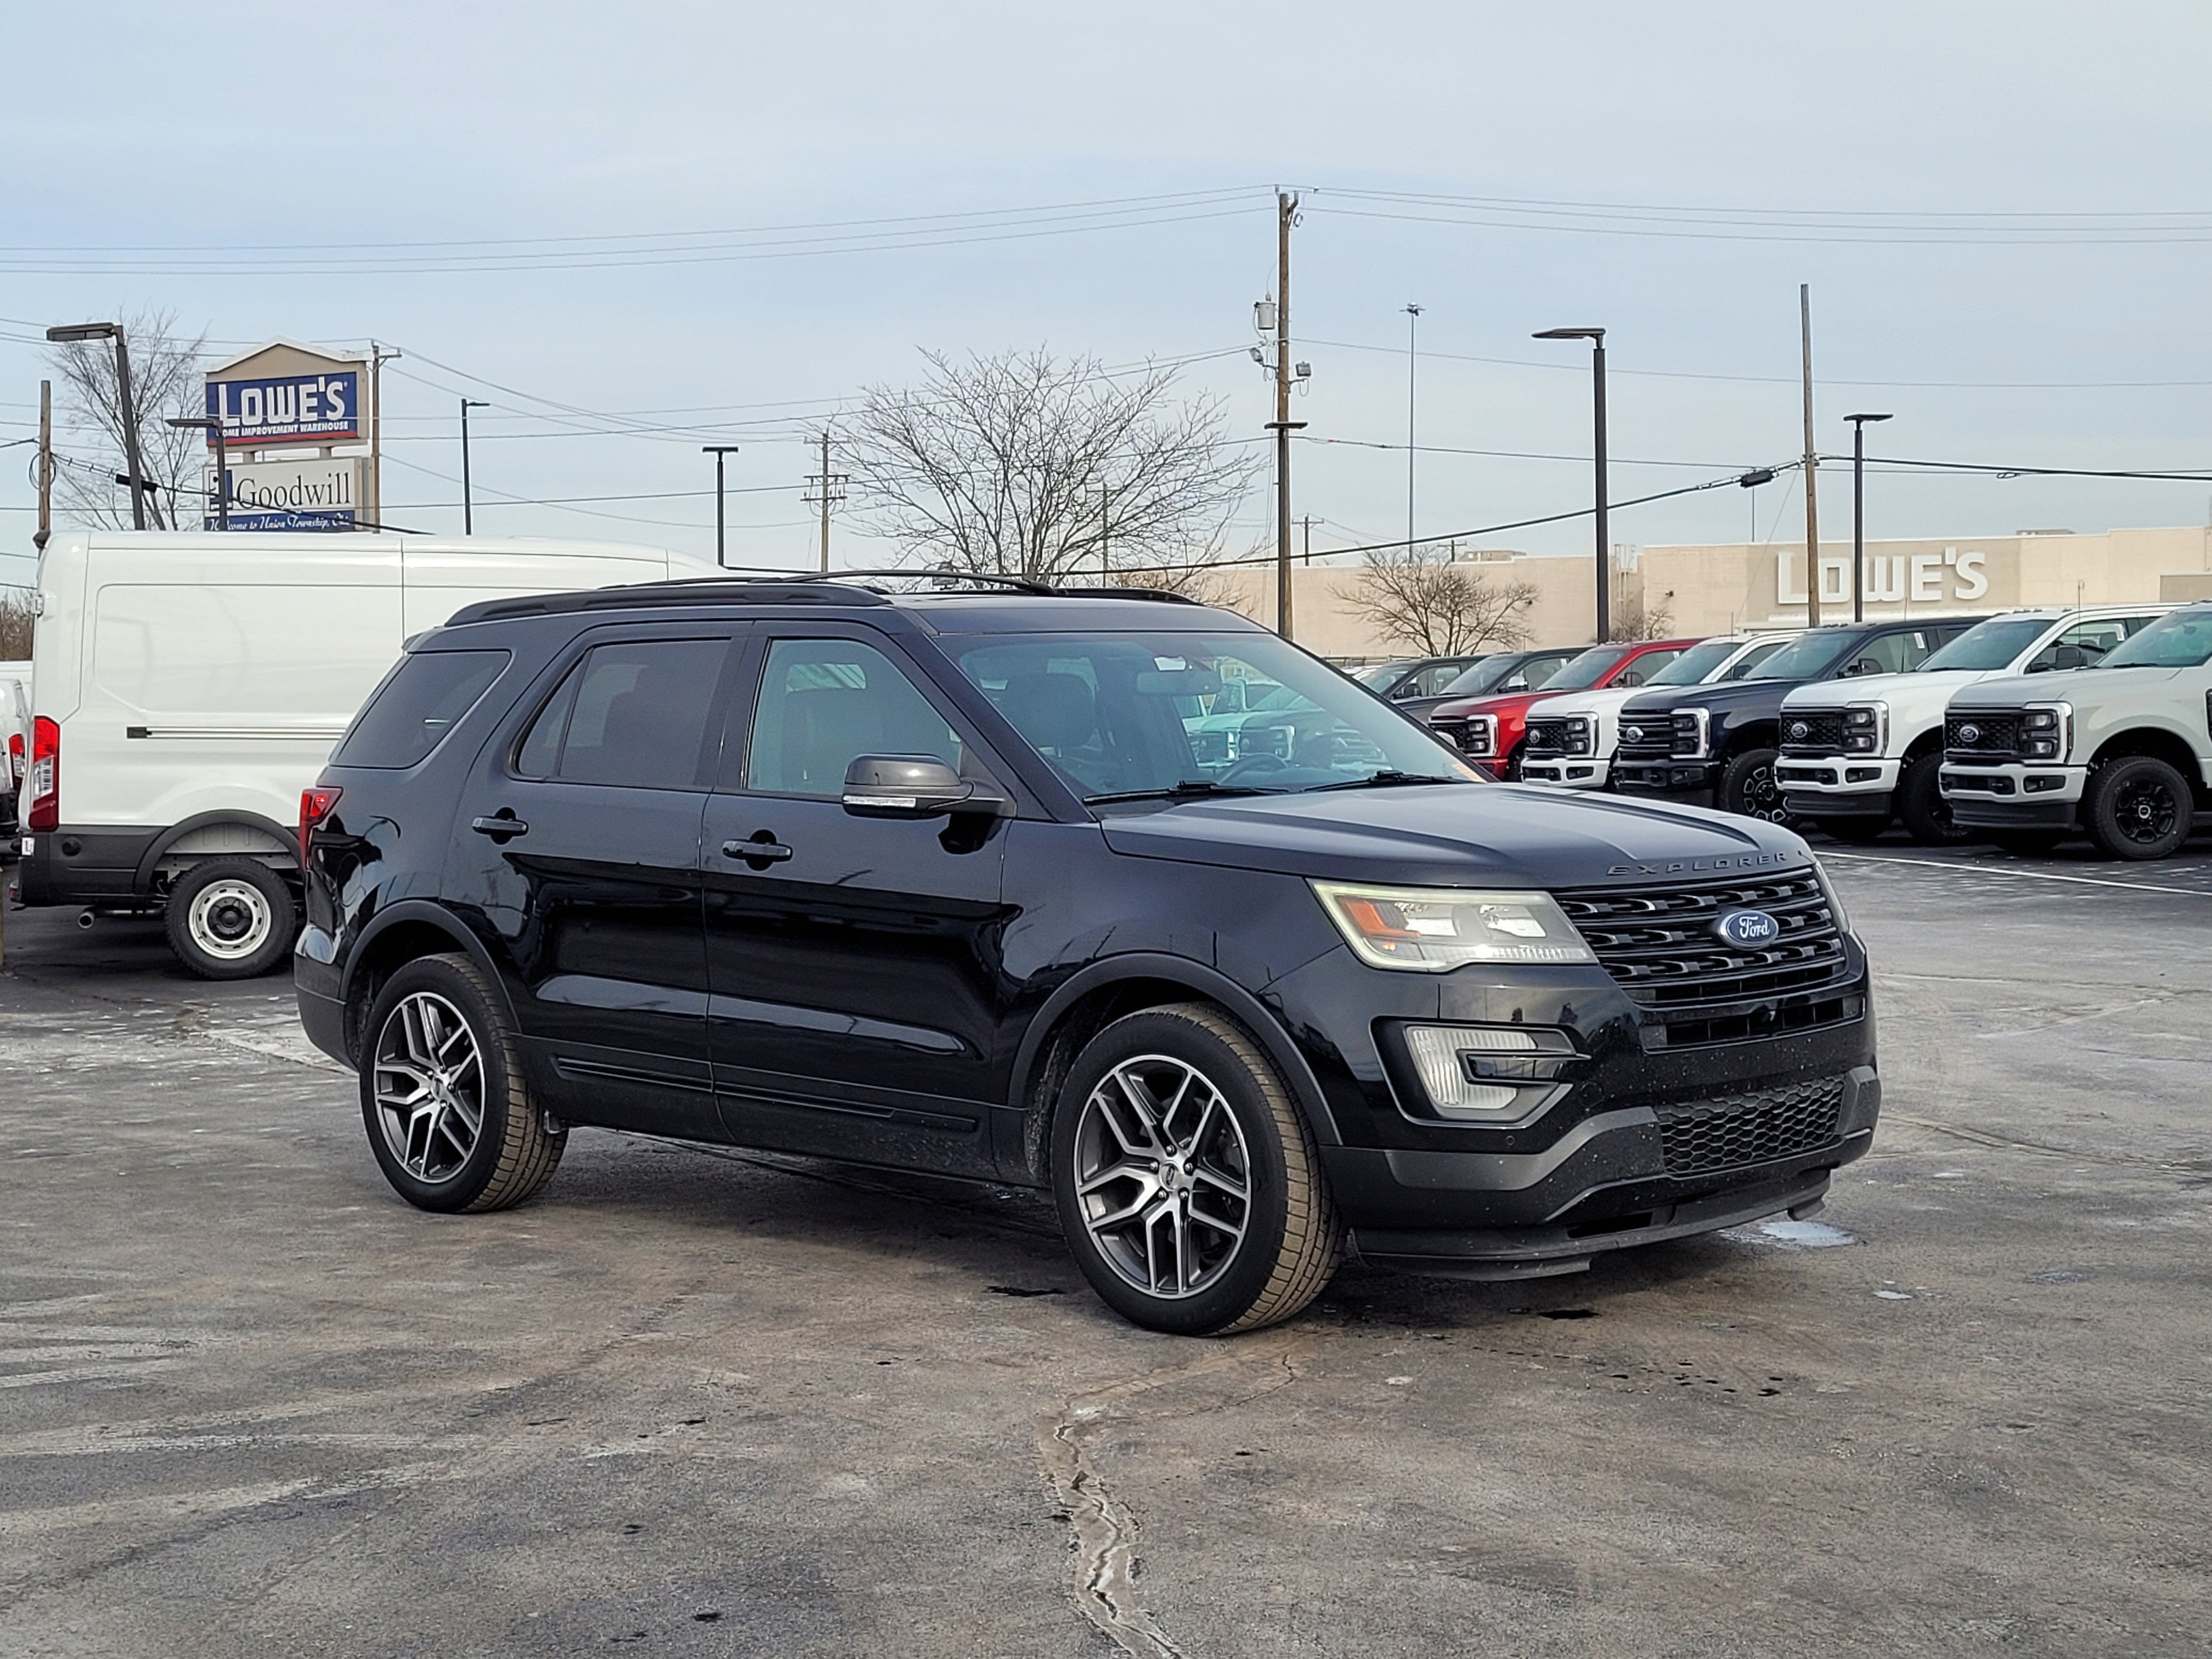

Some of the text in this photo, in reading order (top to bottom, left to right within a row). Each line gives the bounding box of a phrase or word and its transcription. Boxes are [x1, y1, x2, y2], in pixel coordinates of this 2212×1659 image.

[218, 376, 345, 427] LOWE'S
[241, 425, 298, 437] IMPROVEMENT
[300, 421, 348, 432] WAREHOUSE
[236, 472, 351, 509] Goodwill
[210, 518, 247, 531] Wlcome
[249, 521, 257, 529] to
[259, 516, 285, 529] Union
[1778, 548, 1989, 603] LOWE'S
[1607, 851, 1787, 875] EXPLORER
[1739, 915, 1770, 938] Ford
